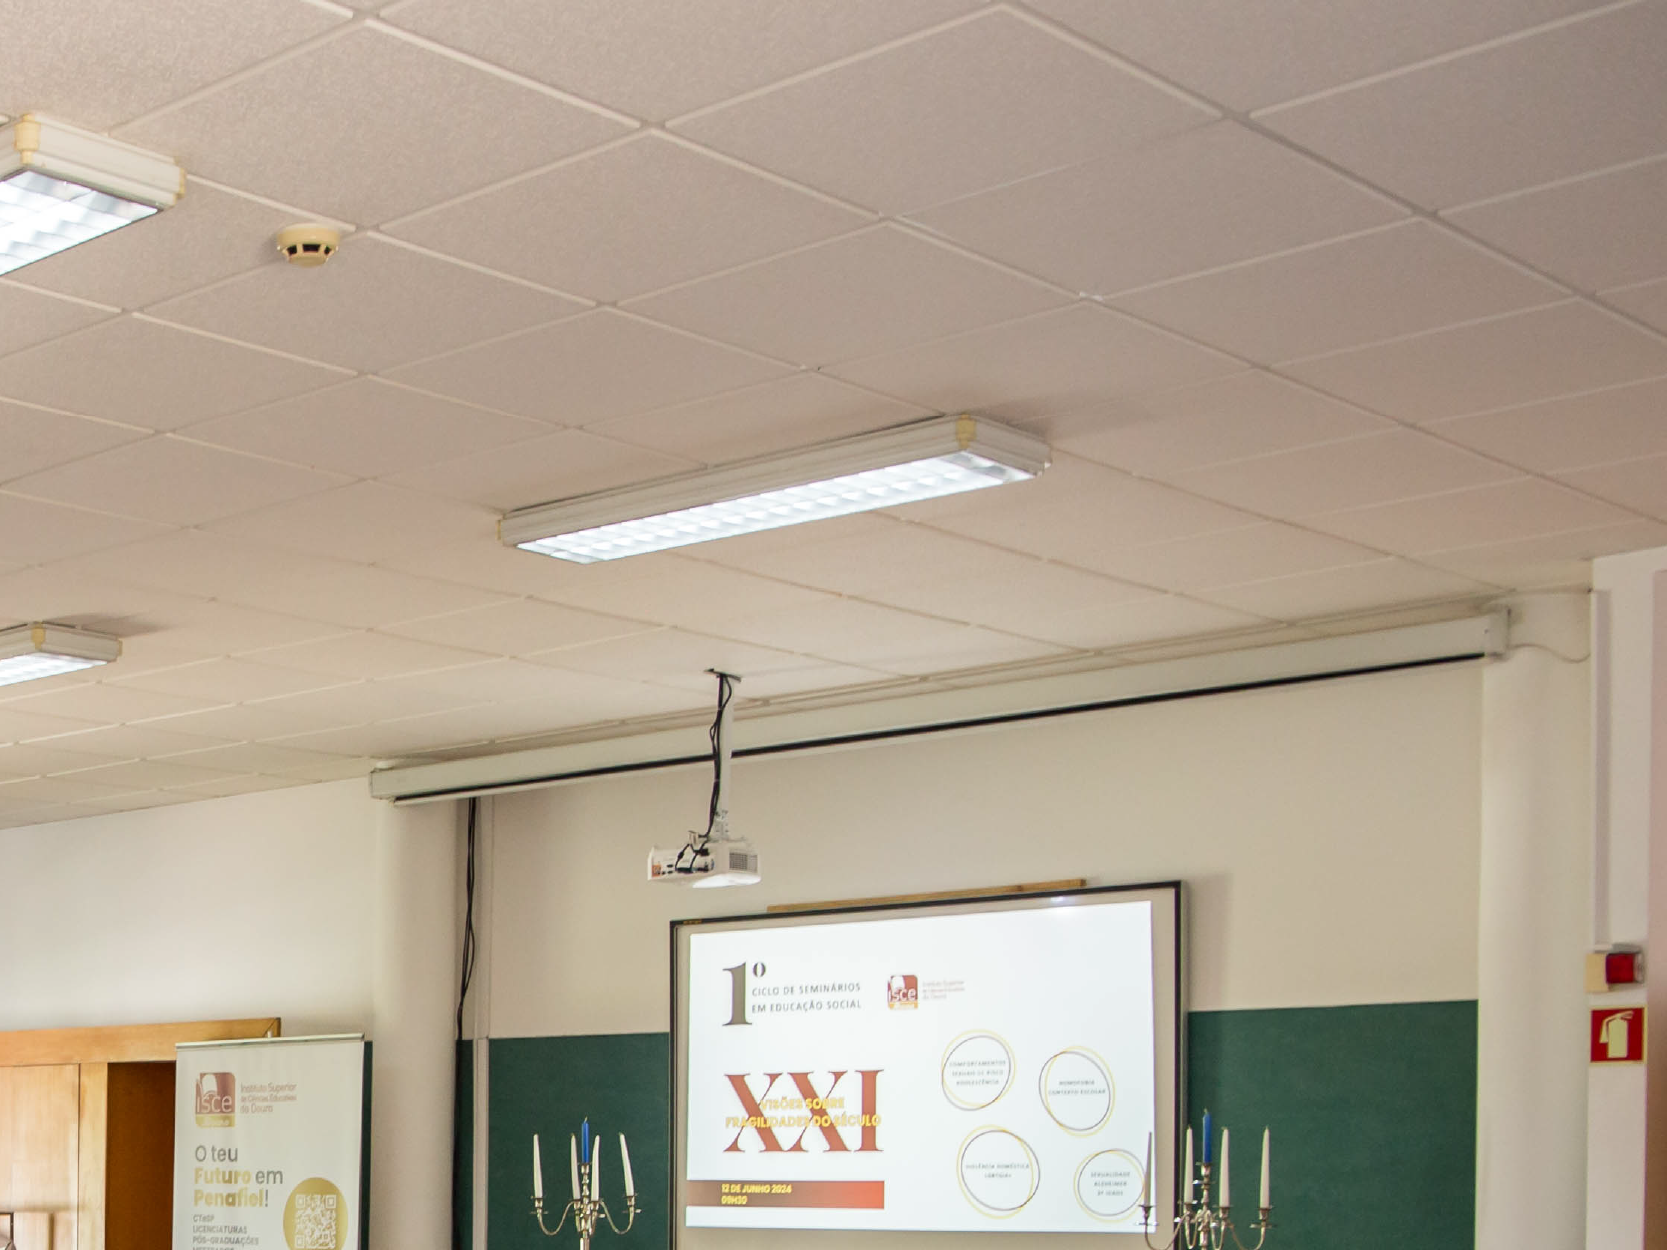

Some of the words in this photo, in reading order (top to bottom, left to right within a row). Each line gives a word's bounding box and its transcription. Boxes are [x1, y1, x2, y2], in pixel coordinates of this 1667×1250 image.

[752, 986, 780, 997] CICLO
[783, 985, 795, 996] DE
[799, 981, 861, 995] SEMINÁRIOS
[752, 1004, 766, 1014] EM
[770, 999, 823, 1013] EDUCAÇÃO
[826, 999, 862, 1010] SOCIAL
[251, 1103, 274, 1113] Douro
[722, 1068, 885, 1153] XXI
[760, 1096, 803, 1111] VISÕES
[805, 1097, 845, 1110] SOBRE
[725, 1114, 810, 1129] FRAGILIDADES
[812, 1114, 832, 1128] DO
[834, 1111, 882, 1128] SÉCULO
[194, 1145, 207, 1162] O
[210, 1145, 239, 1162] teu
[194, 1167, 252, 1185] Futuro
[255, 1169, 284, 1184] em
[742, 1184, 771, 1194] JUNHO
[193, 1187, 269, 1208] Penafiel!
[192, 1225, 248, 1234] LICENCIATURAS
